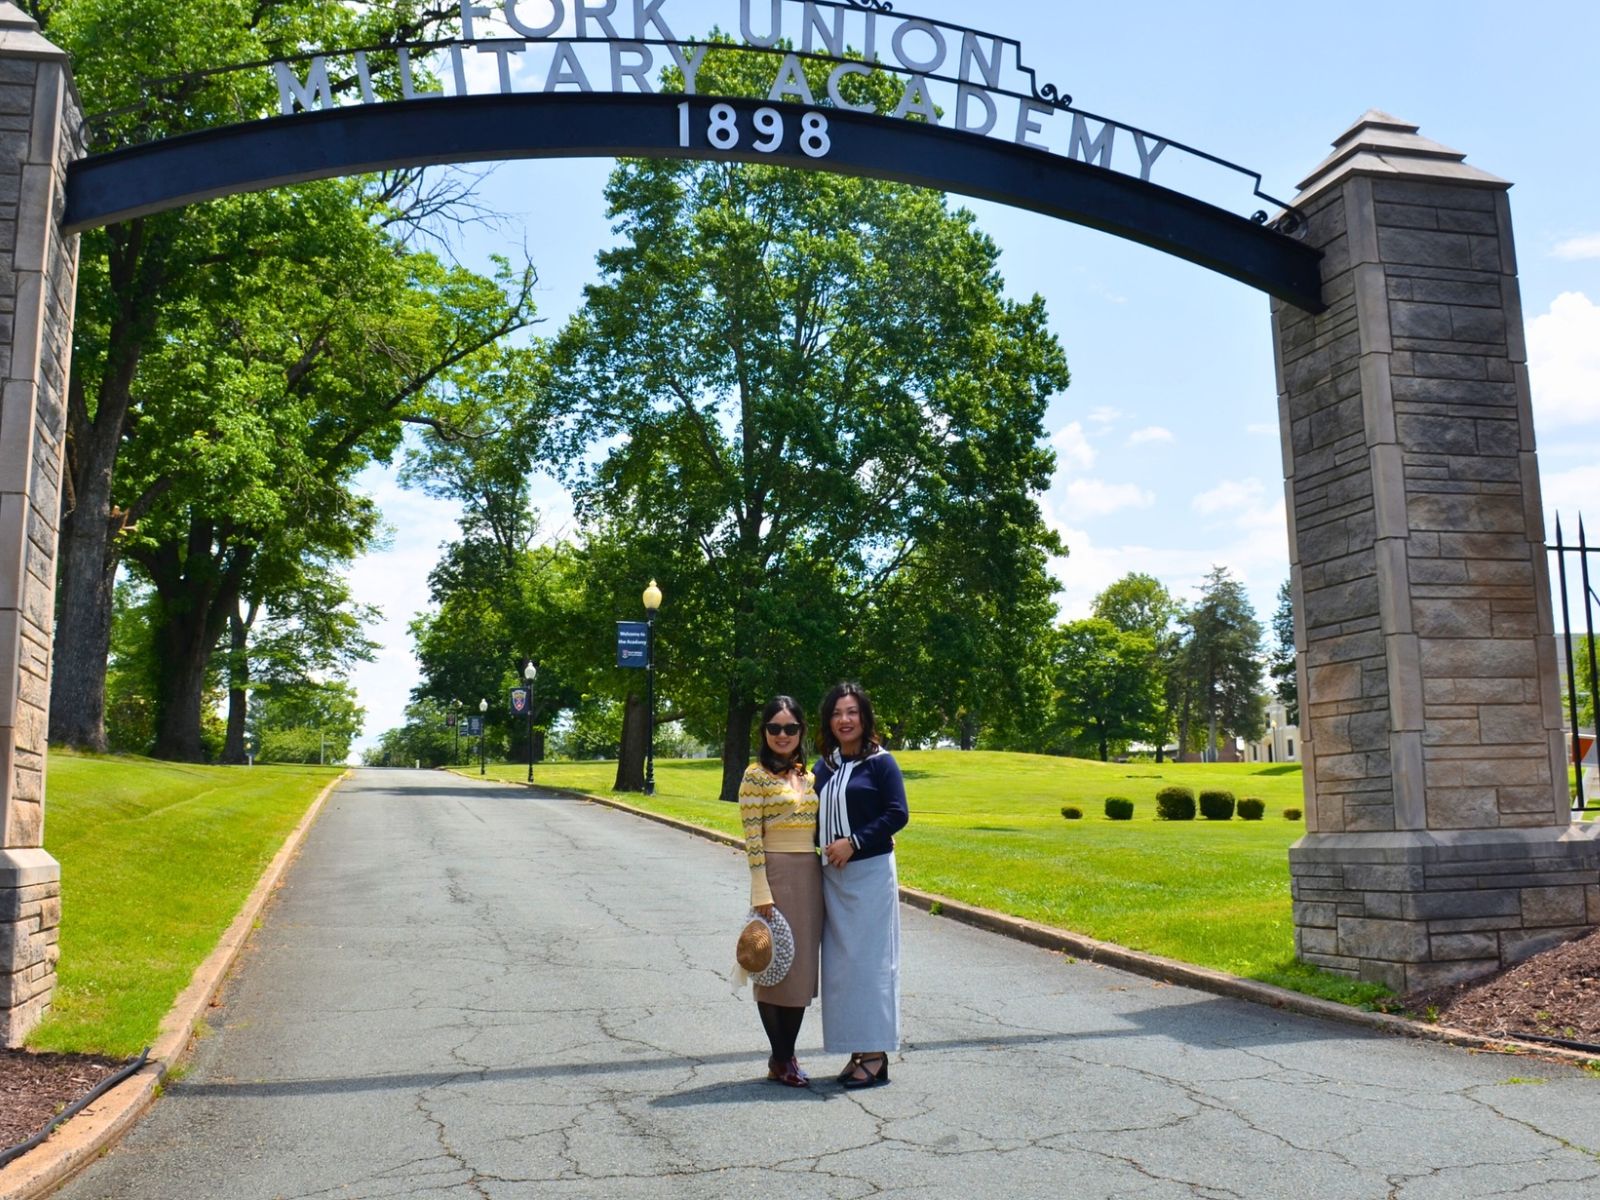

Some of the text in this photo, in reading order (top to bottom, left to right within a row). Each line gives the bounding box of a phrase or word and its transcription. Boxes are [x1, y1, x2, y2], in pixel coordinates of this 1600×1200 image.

[460, 0, 1003, 88] FORK UNION
[273, 40, 1168, 180] MILITARY ACADEMY
[677, 100, 832, 158] 1898
